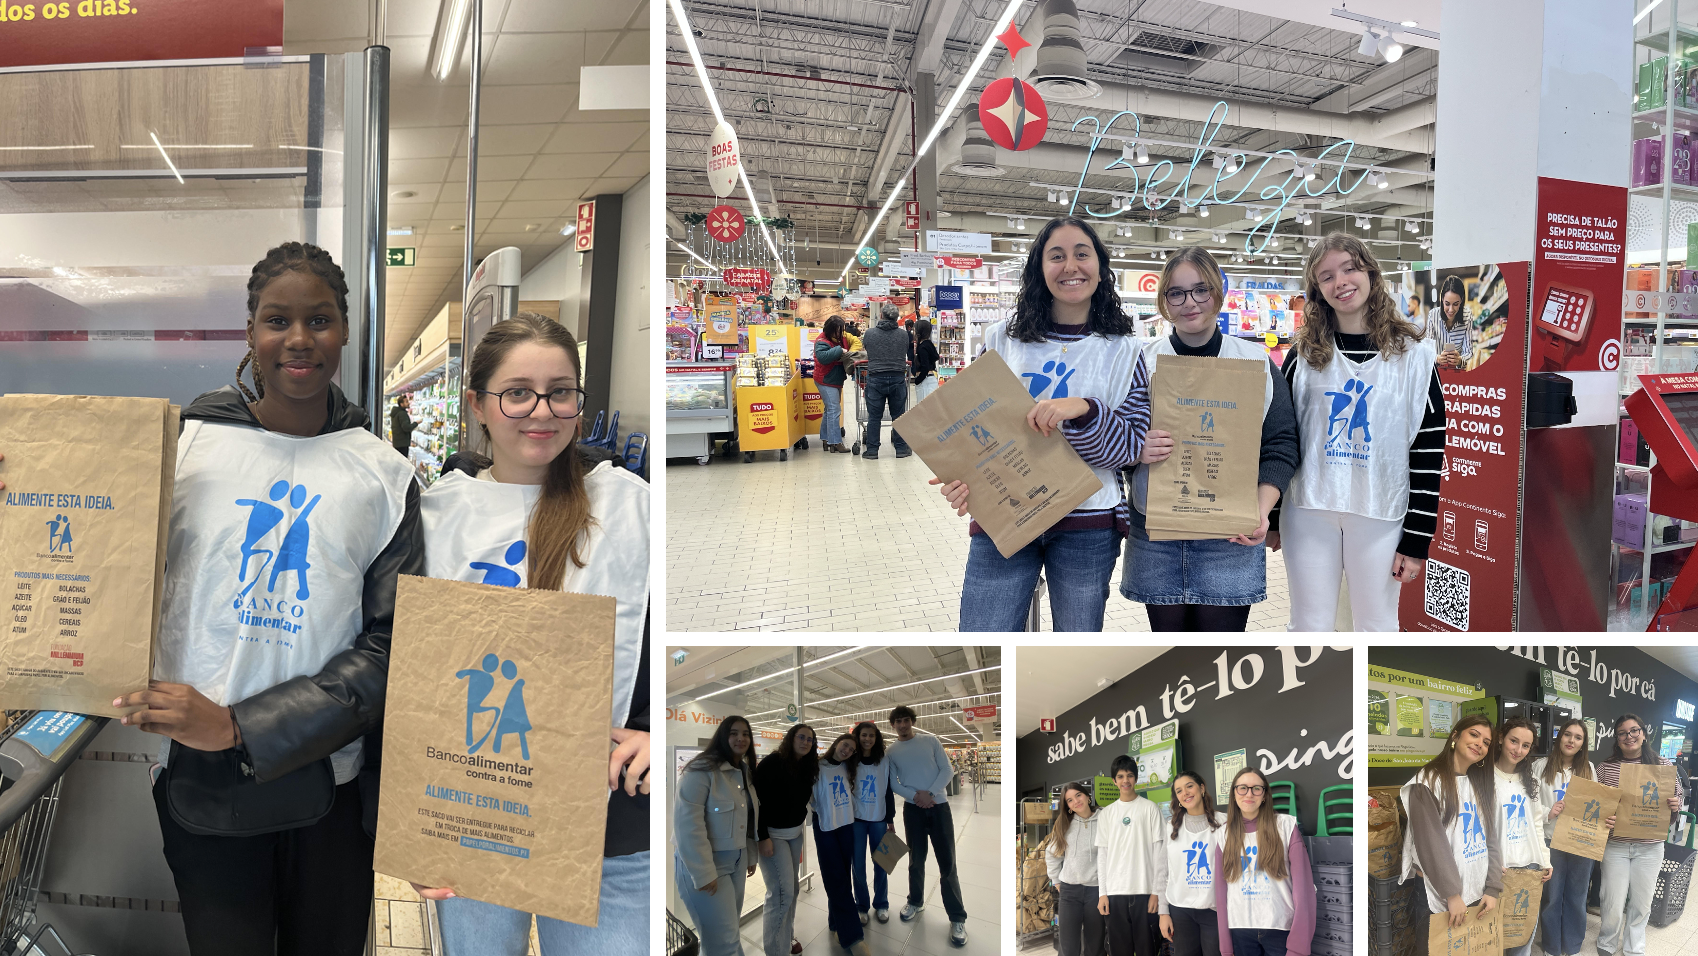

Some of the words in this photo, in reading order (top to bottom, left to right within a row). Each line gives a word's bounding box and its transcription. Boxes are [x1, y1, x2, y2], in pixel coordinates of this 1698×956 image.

[42, 2, 70, 19] os
[712, 141, 732, 157] BOAS
[709, 154, 737, 172] FESTAS
[1070, 101, 1373, 255] Beleza
[1548, 213, 1580, 225] PRECISA
[1582, 216, 1592, 226] DE
[1594, 216, 1618, 229] TALÃO
[1549, 226, 1566, 237] SEM
[1568, 228, 1593, 240] PREÇO
[1595, 230, 1614, 240] PARA
[1541, 239, 1552, 248] OS
[1554, 240, 1574, 250] SEUS
[1576, 241, 1621, 253] PRESENTES?
[849, 272, 869, 283] Pa
[1246, 281, 1284, 290] FRALDAS
[1442, 384, 1506, 400] COMPRAS
[1176, 398, 1205, 408] ALIMENTE
[1206, 400, 1220, 408] ESTA
[1222, 401, 1238, 410] IDEIA.
[1444, 398, 1500, 418] RÁPIDAS
[937, 419, 966, 443] ALIMENTE
[964, 408, 980, 424] ESTA
[978, 398, 997, 414] IDEIA.
[1460, 420, 1490, 434] COM
[1492, 424, 1504, 436] O
[1326, 441, 1370, 452] BANCO
[1326, 449, 1370, 460] alimentar
[6, 492, 54, 508] ALIMENTE
[57, 494, 82, 509] ESTA
[84, 495, 115, 510] IDEIA.
[1463, 502, 1492, 514] Continente
[14, 571, 41, 580] PRODUTOS
[56, 573, 92, 582] NECESSÁRIOS:
[59, 585, 86, 593] BOLACHAS
[12, 604, 32, 612] AÇÚCAR
[53, 596, 67, 604] GRÃO
[72, 596, 90, 604] FEIJÃO
[234, 593, 304, 618] BANCO
[14, 614, 28, 622] ÓLEO
[60, 607, 82, 615] MASSAS
[59, 618, 81, 626] CEREAIS
[238, 610, 302, 634] limentar
[60, 629, 78, 637] ARROZ
[1368, 667, 1386, 679] tos
[1388, 674, 1406, 682] por
[1408, 677, 1425, 686] um
[1427, 679, 1456, 692] bairro
[1456, 685, 1473, 696] feliz
[1558, 646, 1608, 684] tê-lo
[1609, 667, 1640, 698] por
[1641, 678, 1656, 702] cá
[1047, 731, 1087, 764] sabe
[1090, 705, 1150, 748] bem
[1160, 650, 1265, 719] tê-lo
[666, 708, 686, 722] Olá
[691, 711, 726, 725] Vizin
[426, 746, 534, 776] Bancoalimentar
[466, 769, 497, 782] contra
[499, 775, 505, 784] a
[508, 776, 533, 789] fome
[425, 784, 474, 806] ALIMENTE
[476, 795, 500, 810] ESTA
[503, 800, 532, 818] IDEIA.
[418, 807, 431, 818] ESTE
[431, 810, 446, 820] SACO
[446, 814, 455, 822] VAI
[456, 816, 466, 825] SER
[466, 818, 493, 830] ENTREGUE
[494, 823, 508, 832] PARA
[509, 826, 535, 838] RECICLAR
[421, 827, 438, 838] SAIBA
[438, 831, 450, 841] MAIS
[451, 834, 459, 843] EM
[435, 821, 444, 830] EM
[444, 824, 461, 834] TROCA
[462, 827, 469, 835] DE
[470, 828, 484, 838] MAIS
[484, 831, 515, 844] ALIMENTOS.
